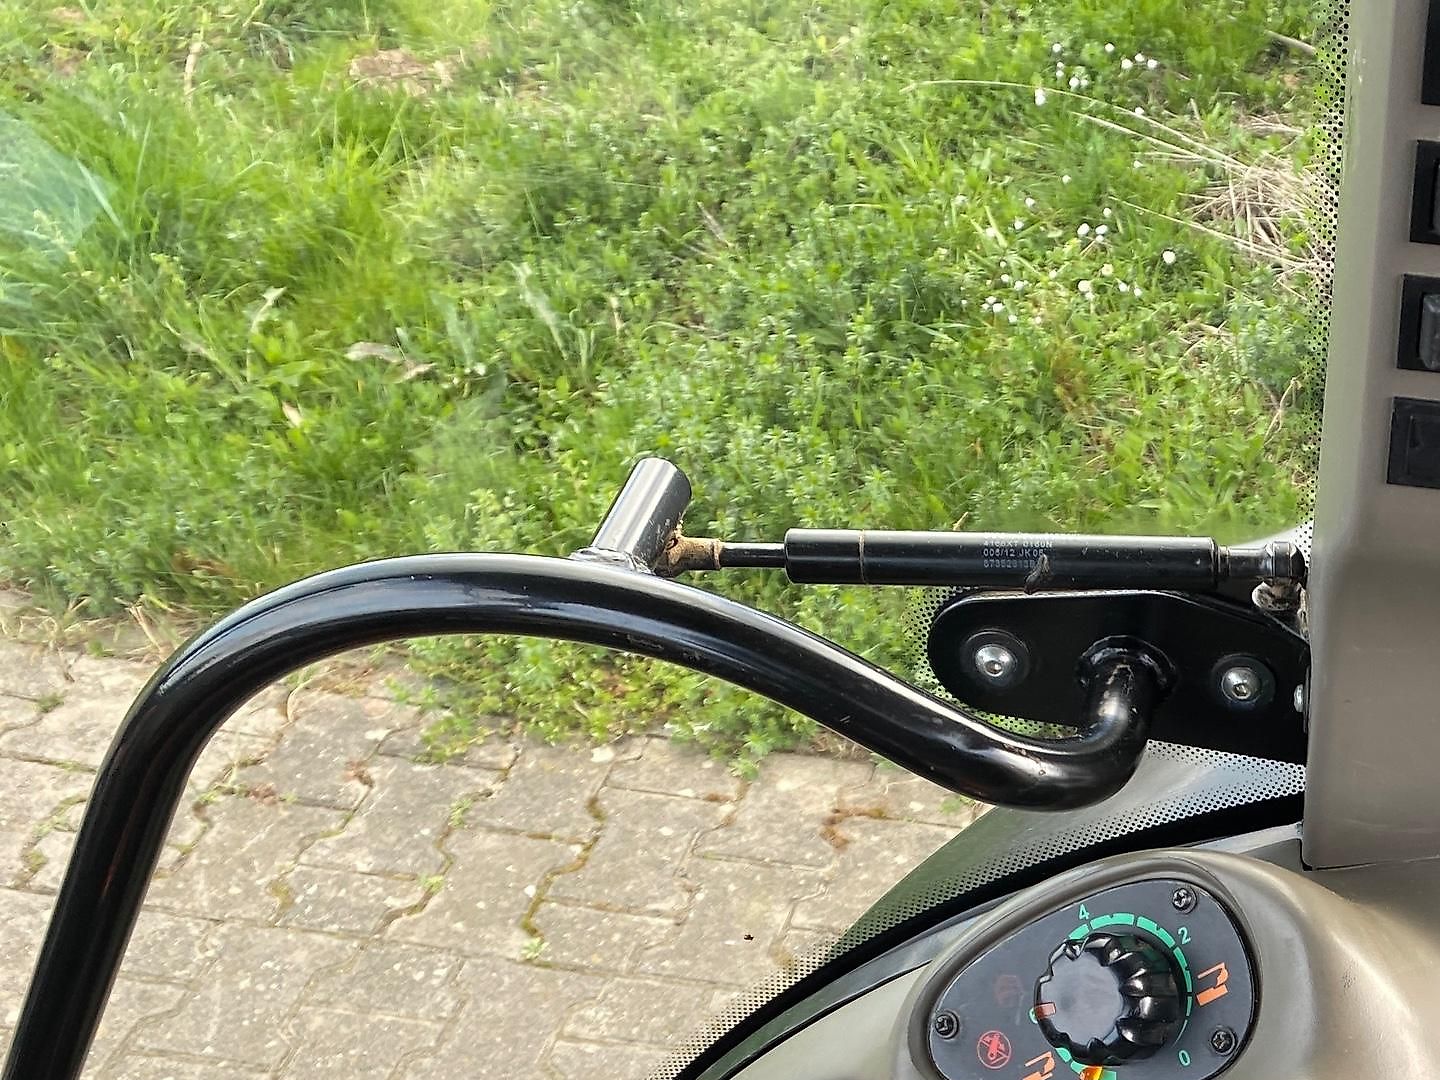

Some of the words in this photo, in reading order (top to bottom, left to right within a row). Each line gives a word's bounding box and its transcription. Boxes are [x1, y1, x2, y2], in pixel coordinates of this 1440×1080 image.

[1077, 903, 1091, 921] 4
[1177, 927, 1192, 945] 2
[1177, 1050, 1192, 1067] 0
